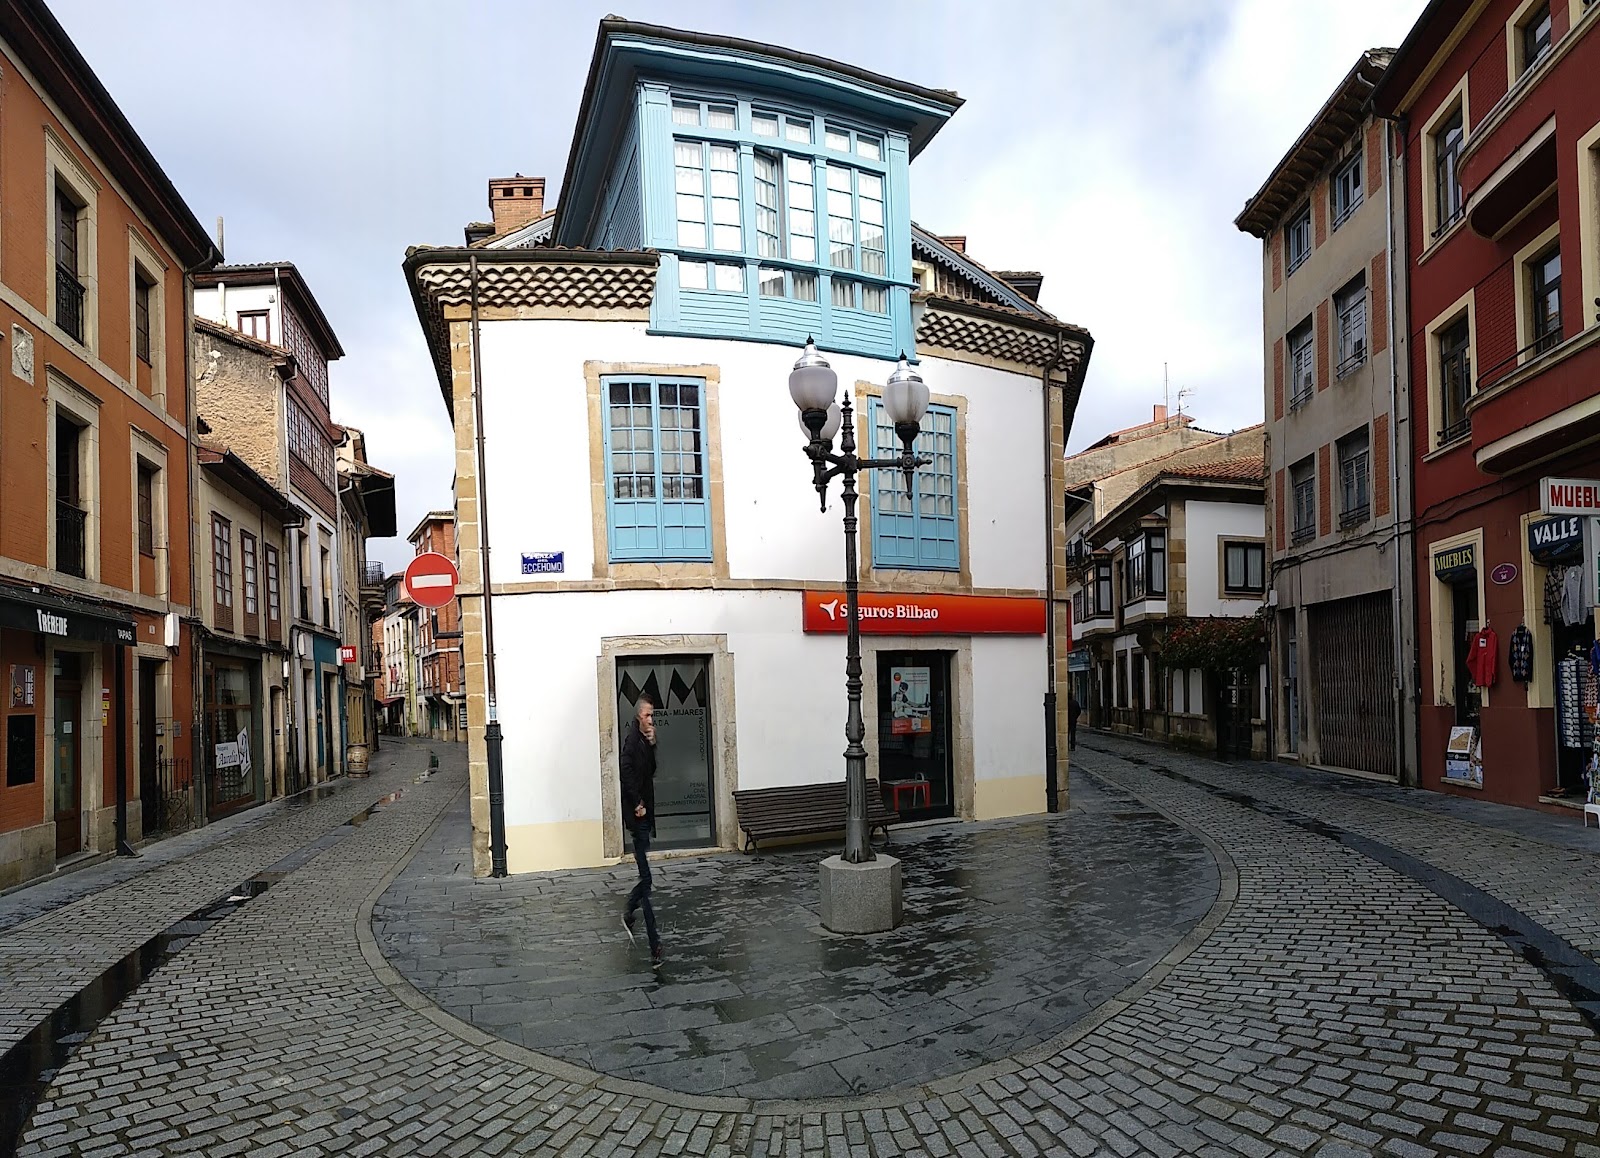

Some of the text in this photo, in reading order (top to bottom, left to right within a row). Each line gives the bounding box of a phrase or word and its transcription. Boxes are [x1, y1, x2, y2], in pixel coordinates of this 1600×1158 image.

[1534, 516, 1579, 546] VALLE
[523, 562, 562, 573] ECCEHOMO
[1435, 549, 1473, 571] MUEBLES
[840, 603, 939, 620] Sguros Bilbao
[36, 608, 68, 636] TRÉBEDE
[117, 628, 133, 641] TAPAS
[673, 708, 704, 717] MIJARES
